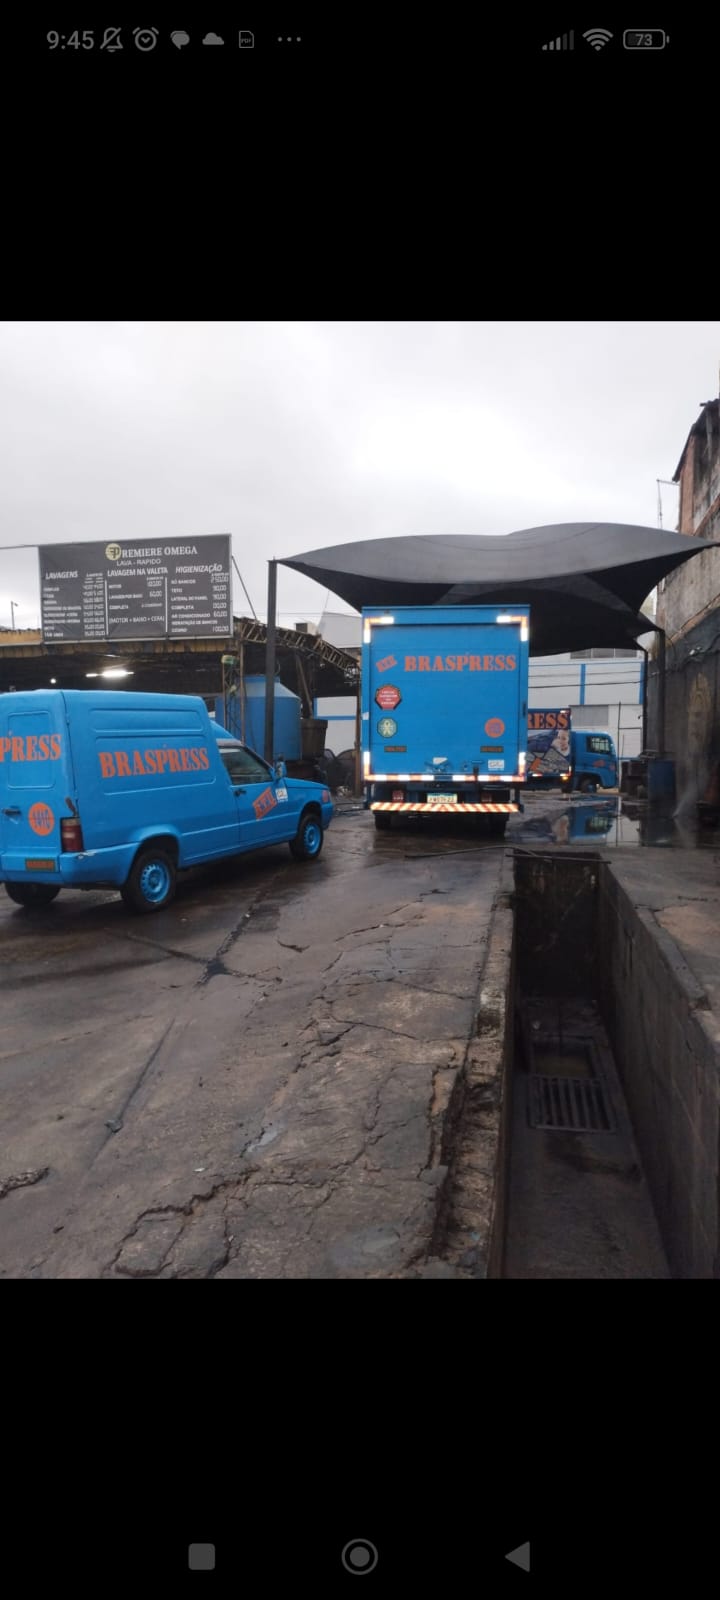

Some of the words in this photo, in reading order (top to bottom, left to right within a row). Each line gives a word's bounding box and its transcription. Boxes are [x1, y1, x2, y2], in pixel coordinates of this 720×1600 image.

[163, 546, 199, 556] OMEGA
[45, 570, 79, 580] LAVAGENS
[107, 569, 136, 577] LAVAGEM
[146, 567, 169, 575] VALETA
[403, 654, 517, 672] BRASPRESS
[98, 746, 210, 778] BRASPRESS
